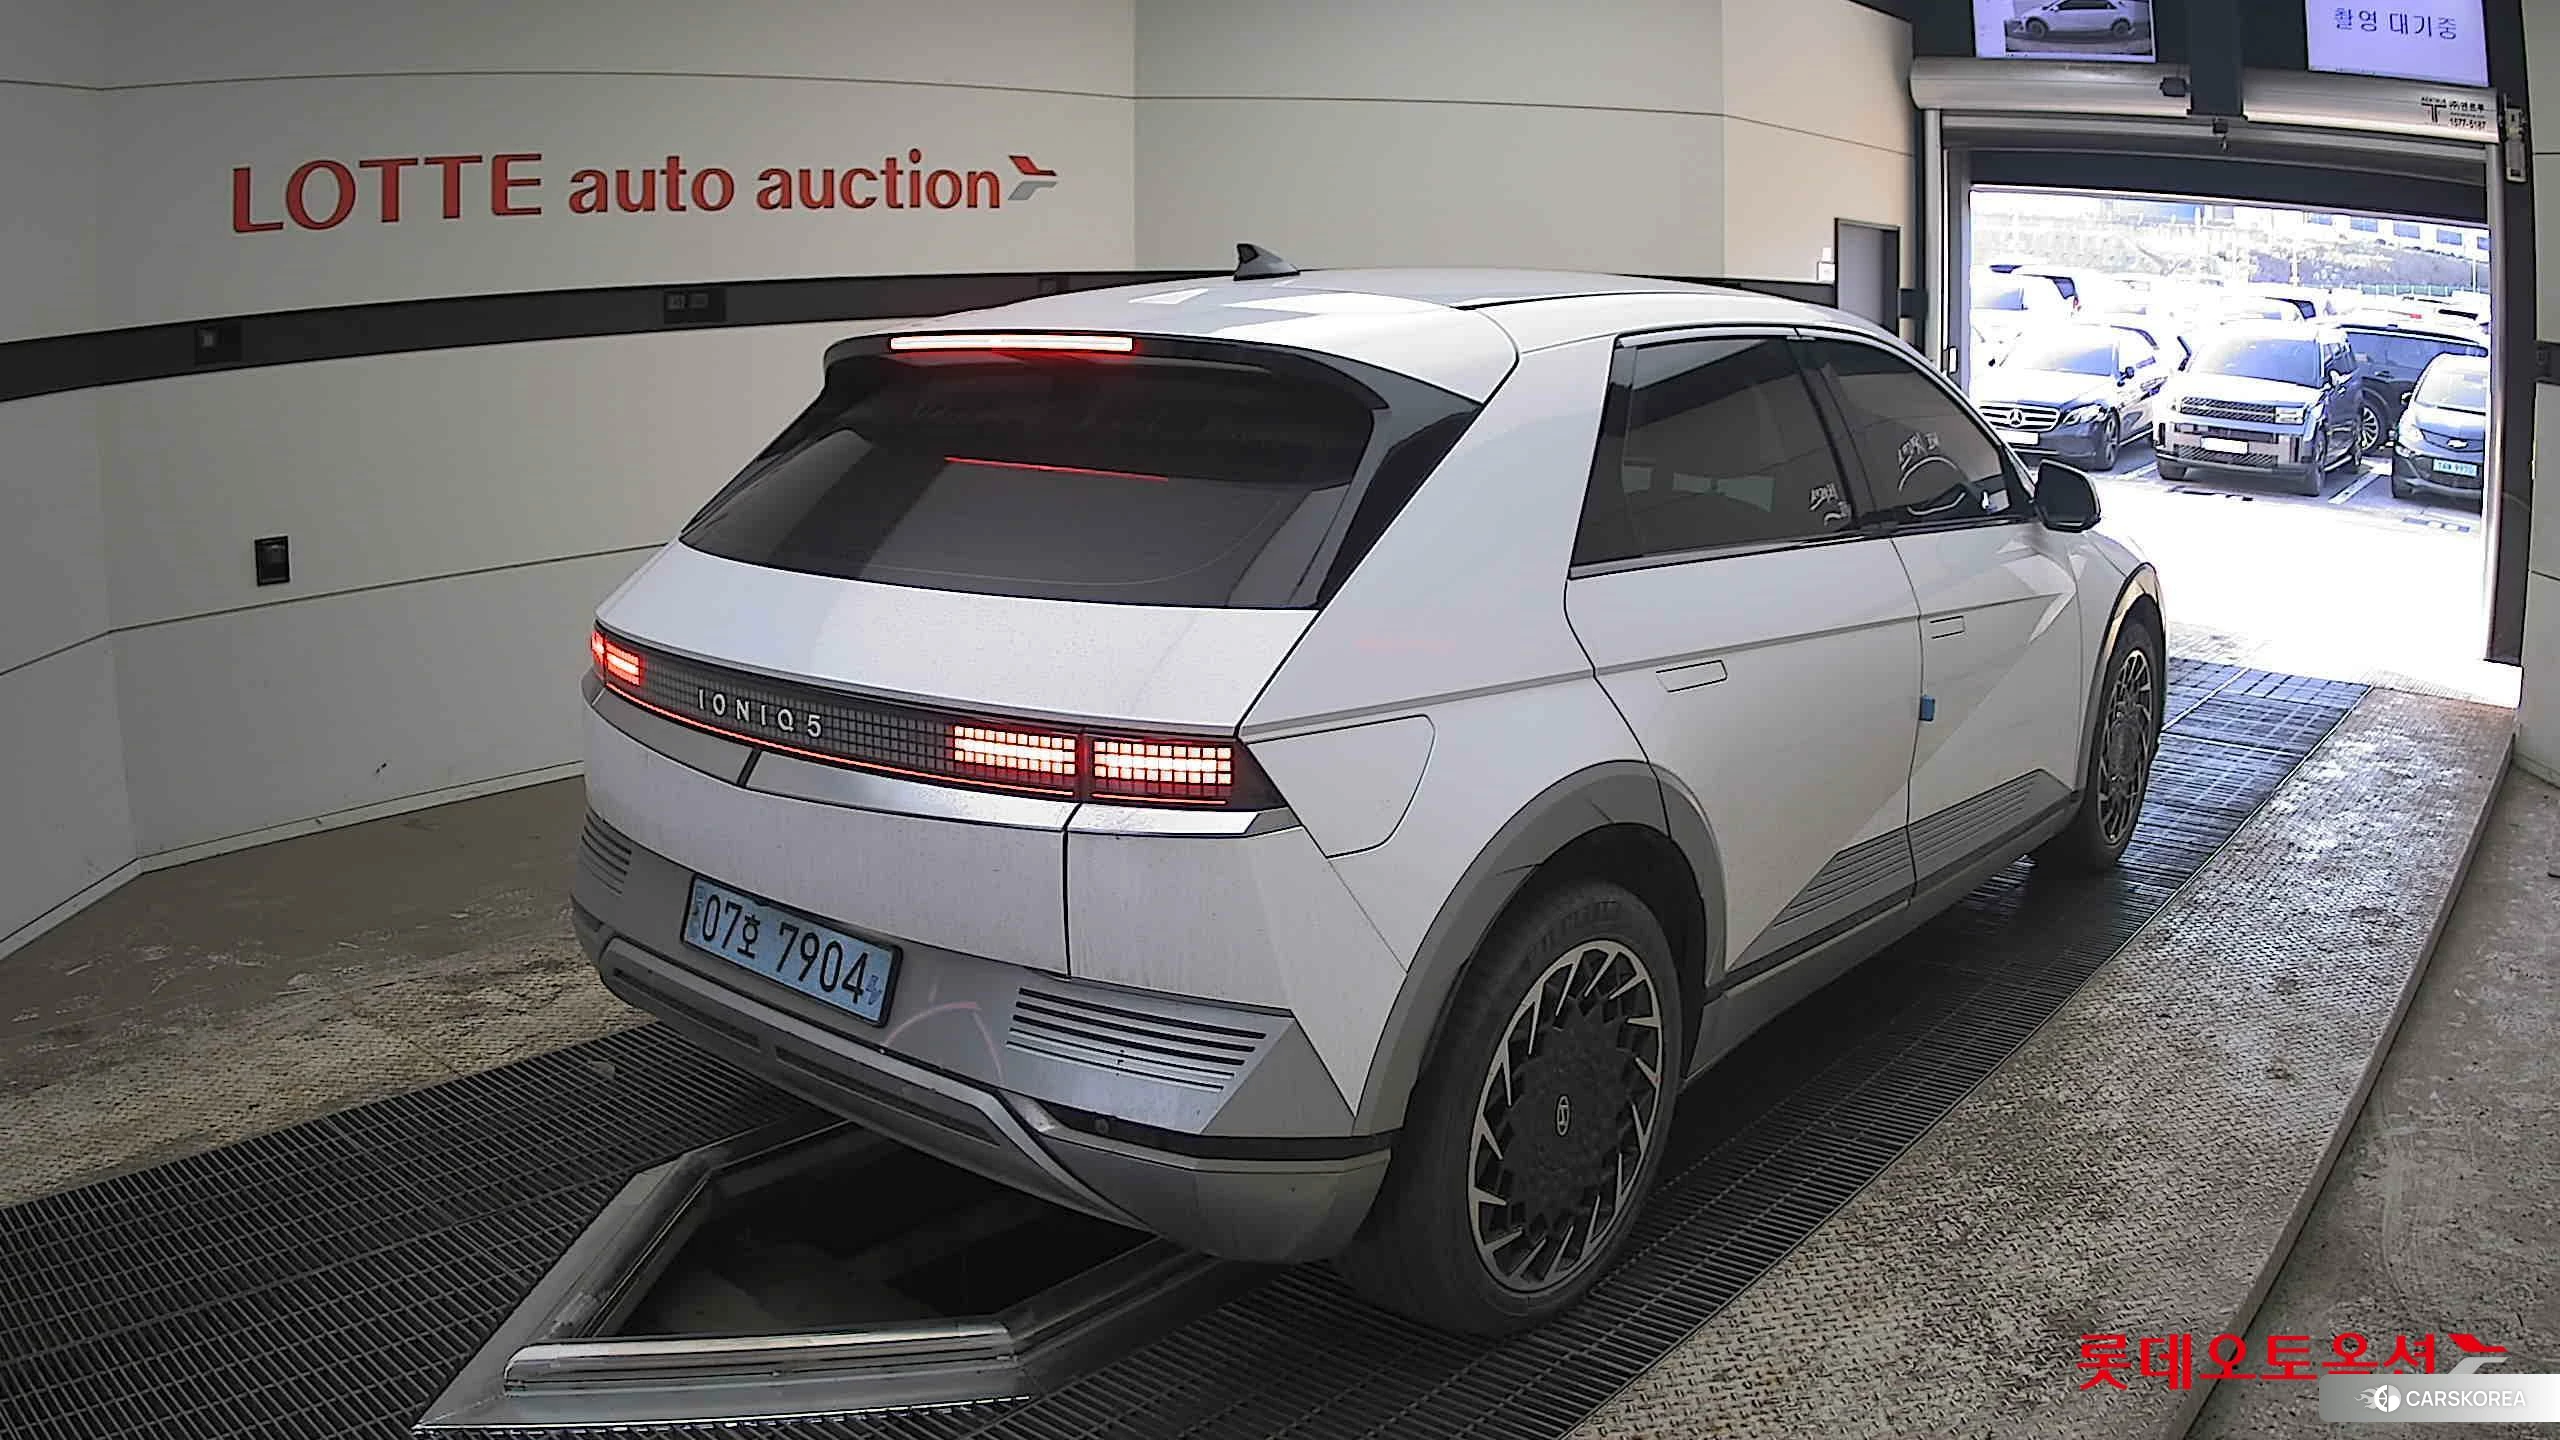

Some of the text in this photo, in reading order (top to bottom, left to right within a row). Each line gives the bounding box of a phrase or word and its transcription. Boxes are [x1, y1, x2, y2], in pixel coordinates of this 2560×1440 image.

[2335, 7, 2457, 40] 촬영 대기중
[233, 149, 1001, 233] LOTTE auto auction
[698, 688, 822, 738] IONIQ 5
[702, 894, 761, 960] 07호
[776, 921, 869, 1005] 7904
